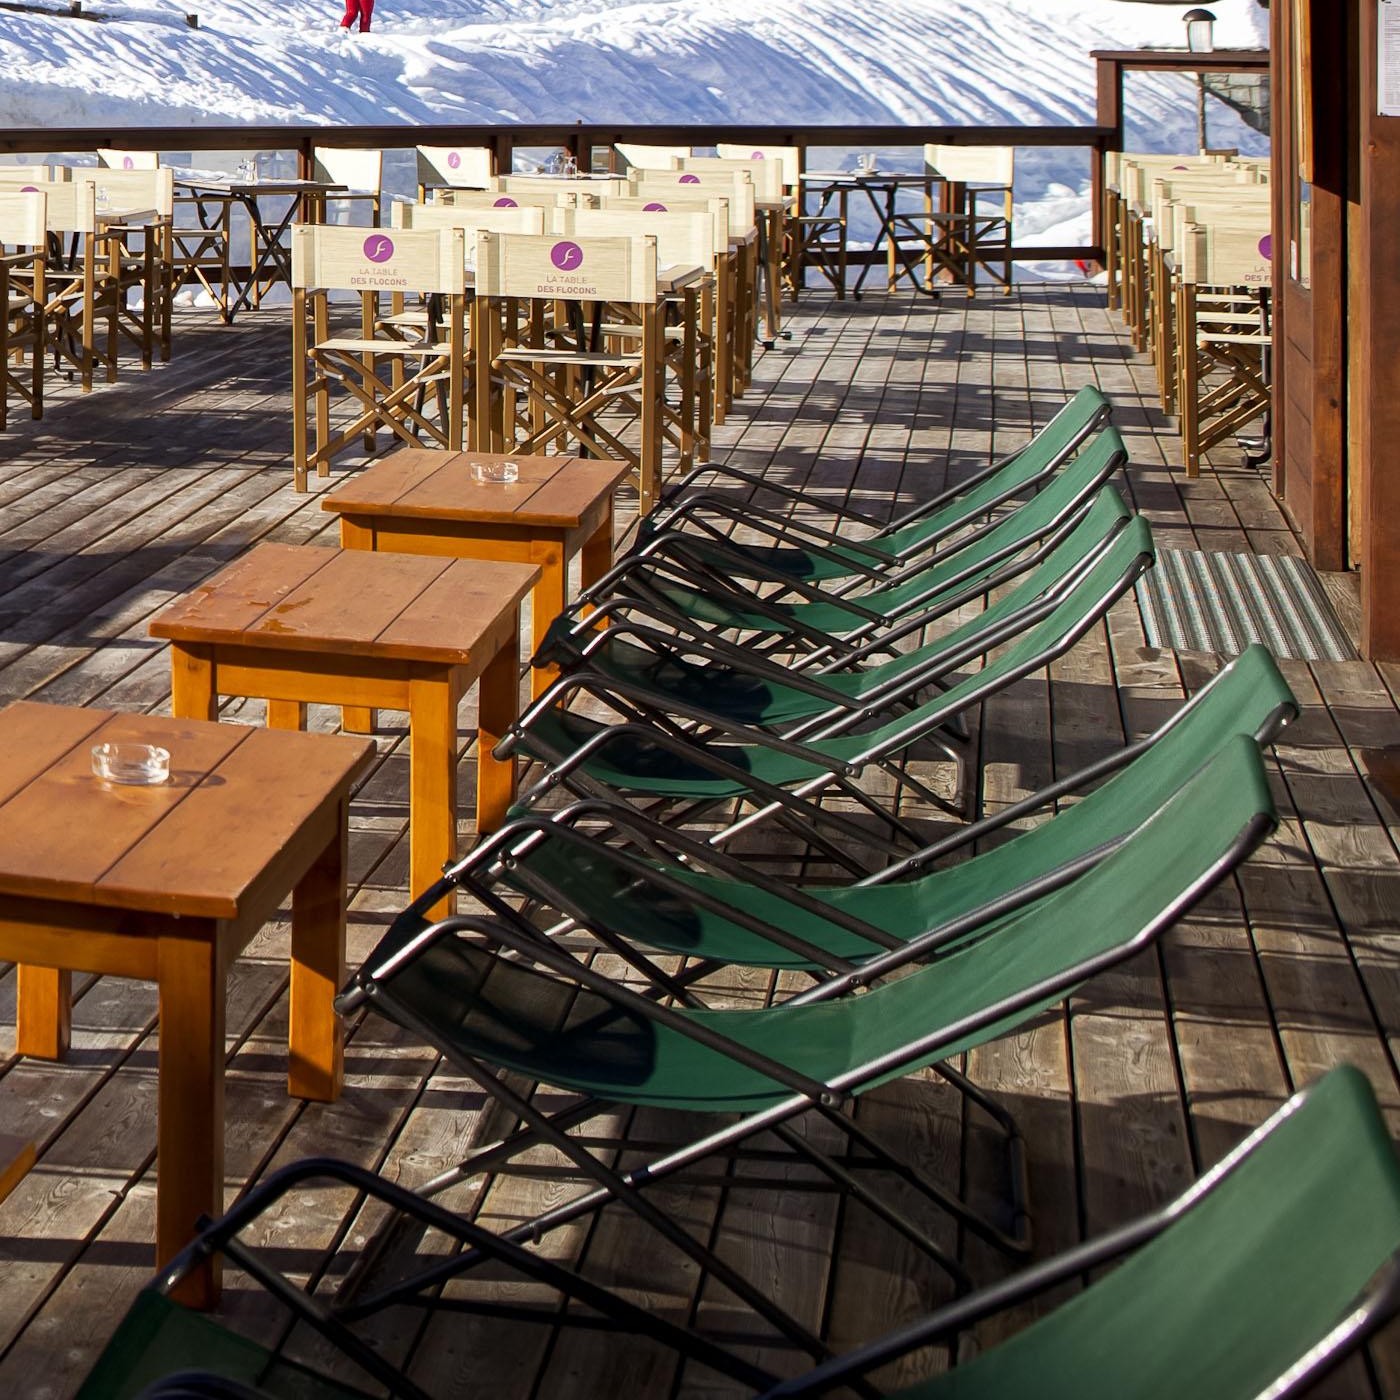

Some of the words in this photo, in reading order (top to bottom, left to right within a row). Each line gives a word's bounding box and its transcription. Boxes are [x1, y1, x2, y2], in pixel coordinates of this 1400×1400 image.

[351, 277, 367, 285] DES
[369, 277, 408, 286] FLOCONS
[546, 275, 557, 283] LA
[559, 276, 587, 284] TABLE
[537, 285, 554, 293] DES
[556, 286, 597, 295] FLOCONS
